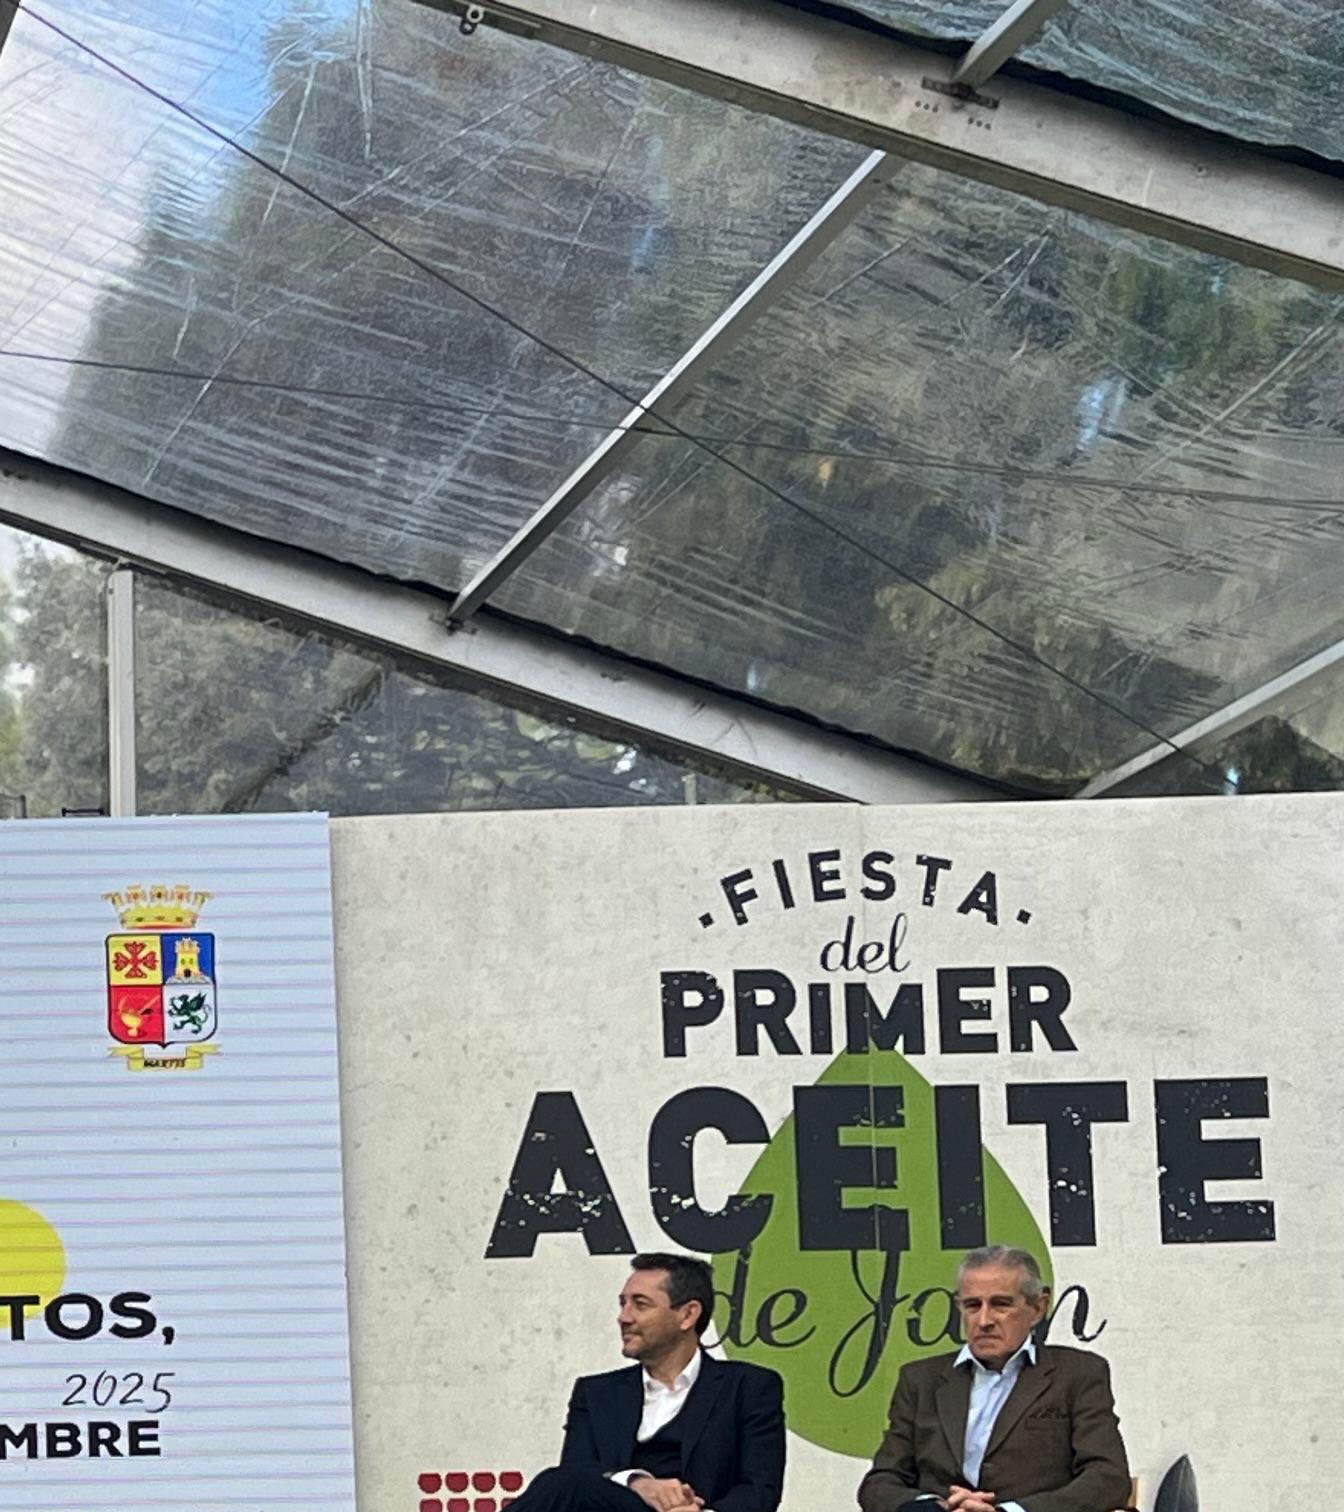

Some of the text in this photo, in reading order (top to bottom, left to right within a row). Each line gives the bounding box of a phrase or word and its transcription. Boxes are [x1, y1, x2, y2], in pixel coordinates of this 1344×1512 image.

[820, 913, 909, 974] del
[660, 965, 1080, 1059] PRIMER
[484, 1075, 1277, 1260] ACEITE
[828, 1206, 1106, 1400] Jan
[62, 1371, 176, 1413] 2025
